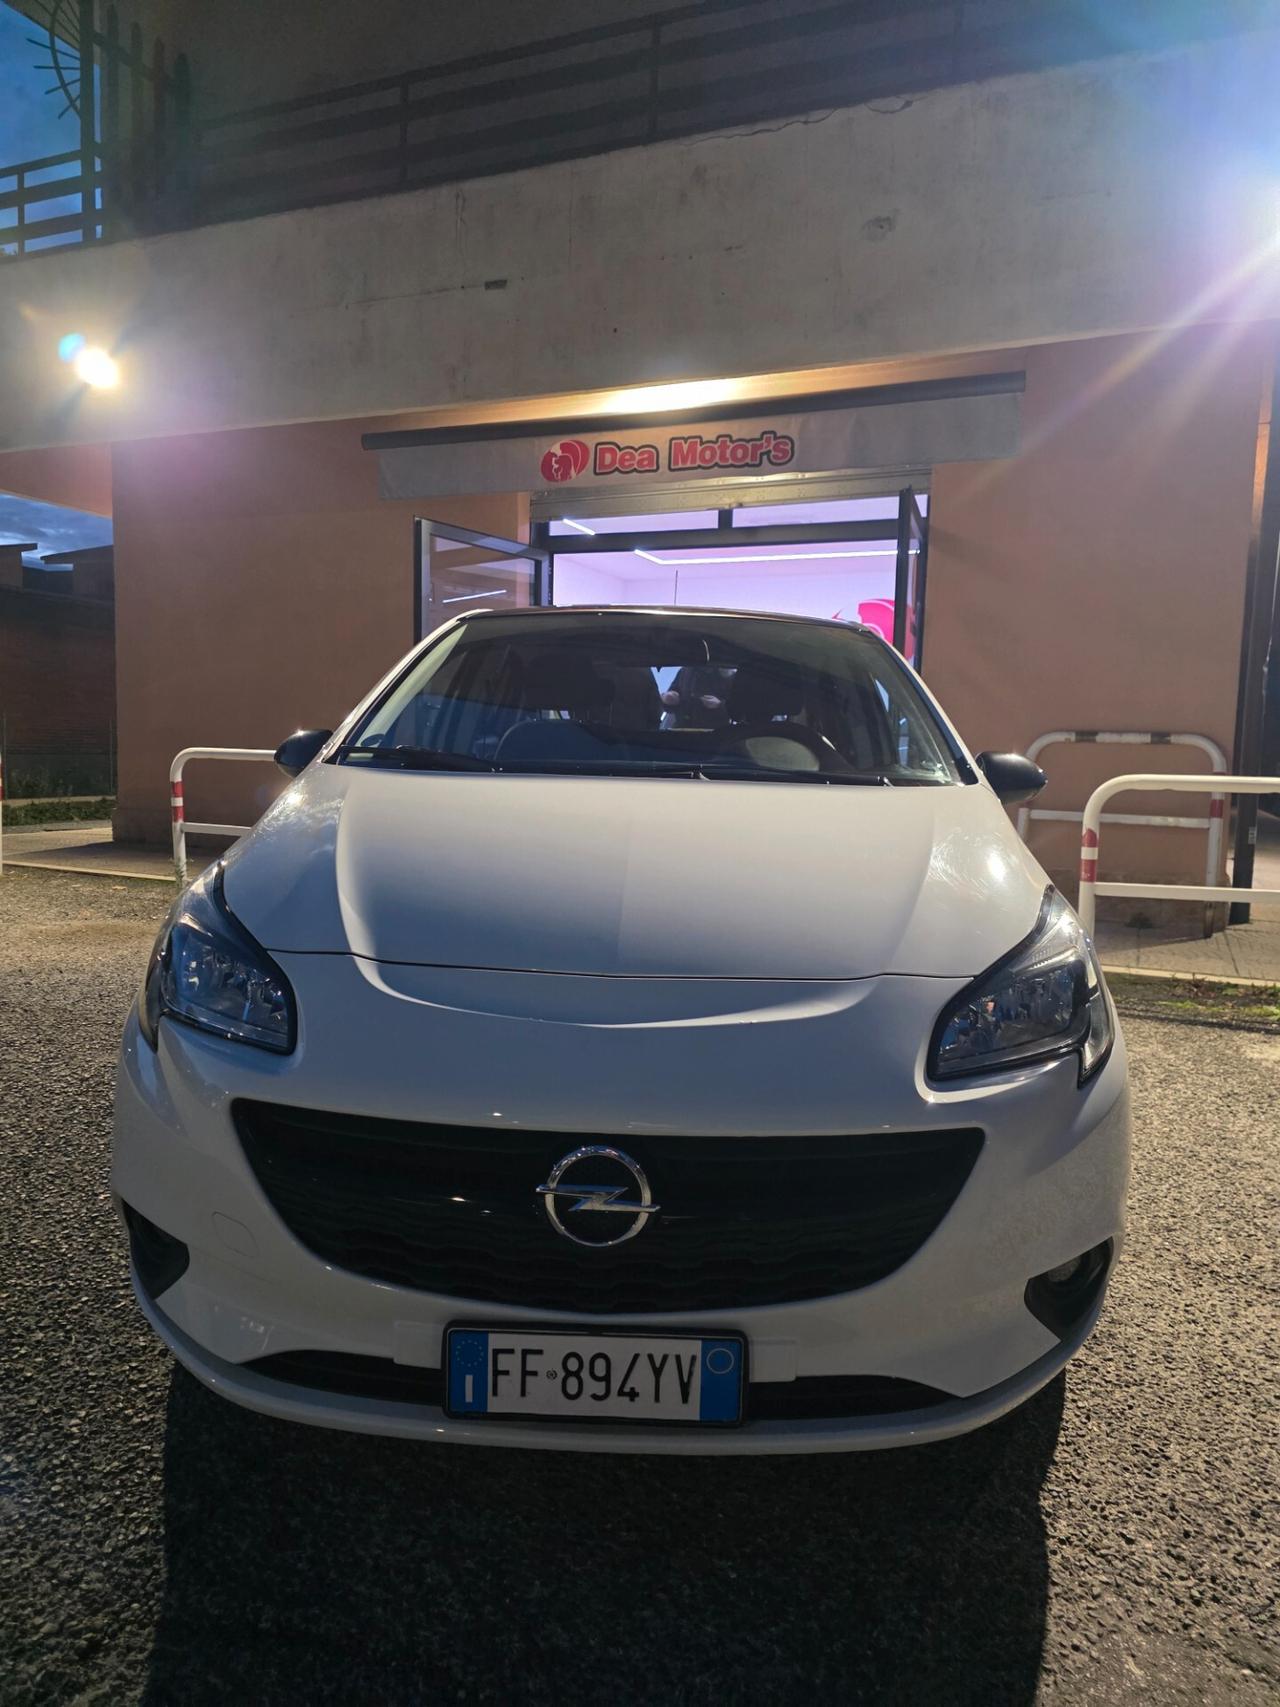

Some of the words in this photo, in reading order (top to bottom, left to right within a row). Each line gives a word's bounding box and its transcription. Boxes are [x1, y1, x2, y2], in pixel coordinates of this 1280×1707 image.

[594, 442, 659, 475] Dea
[669, 431, 794, 471] Motor's
[464, 1374, 473, 1403] I
[491, 1348, 544, 1398] FF
